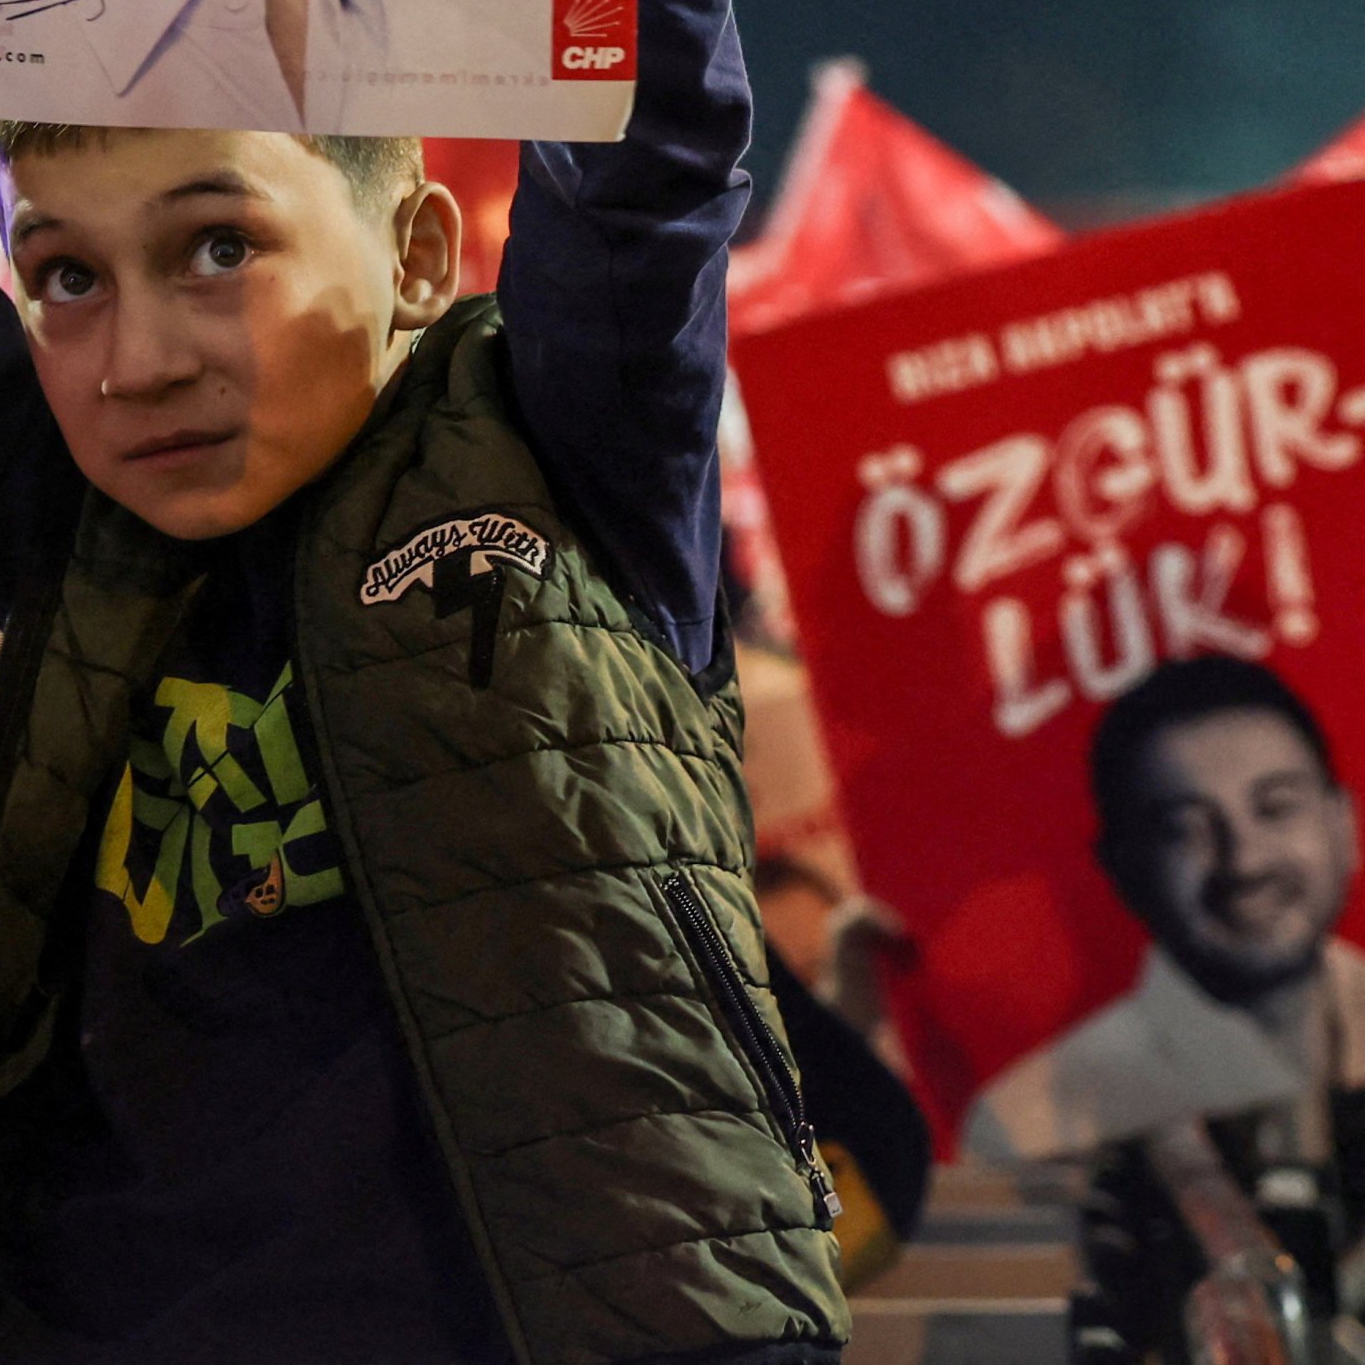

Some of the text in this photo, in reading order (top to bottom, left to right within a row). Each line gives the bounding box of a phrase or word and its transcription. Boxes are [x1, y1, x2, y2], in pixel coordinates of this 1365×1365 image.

[562, 46, 625, 71] CHP
[366, 517, 541, 596] Always With
[982, 503, 1320, 737] LÜK!
